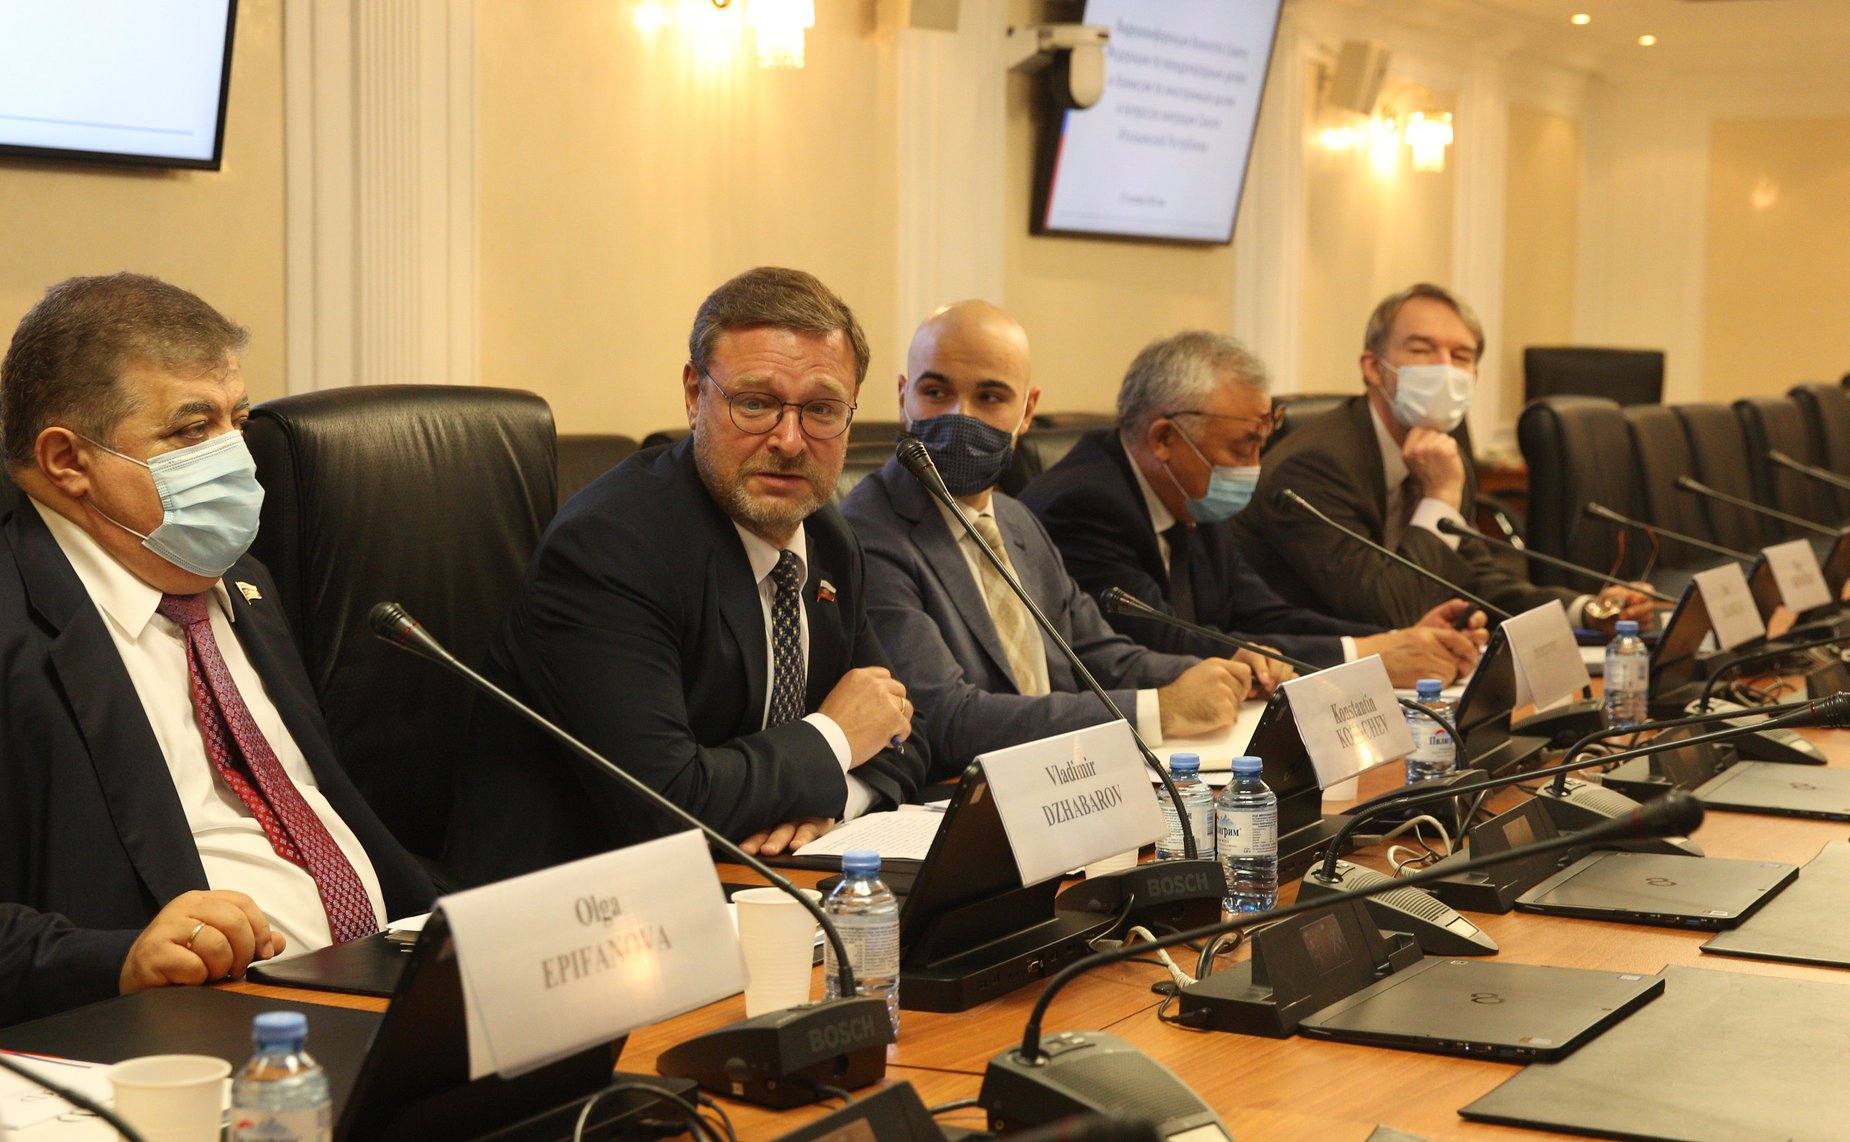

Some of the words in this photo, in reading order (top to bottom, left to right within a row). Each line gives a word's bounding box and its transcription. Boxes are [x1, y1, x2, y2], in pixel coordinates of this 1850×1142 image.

[1330, 694, 1377, 724] Konstantin
[1045, 757, 1096, 786] Vladimir
[1042, 784, 1123, 826] DZHABAROV
[1147, 871, 1209, 897] BOSCH
[574, 895, 622, 928] Olga
[808, 1015, 875, 1052] BOSCH
